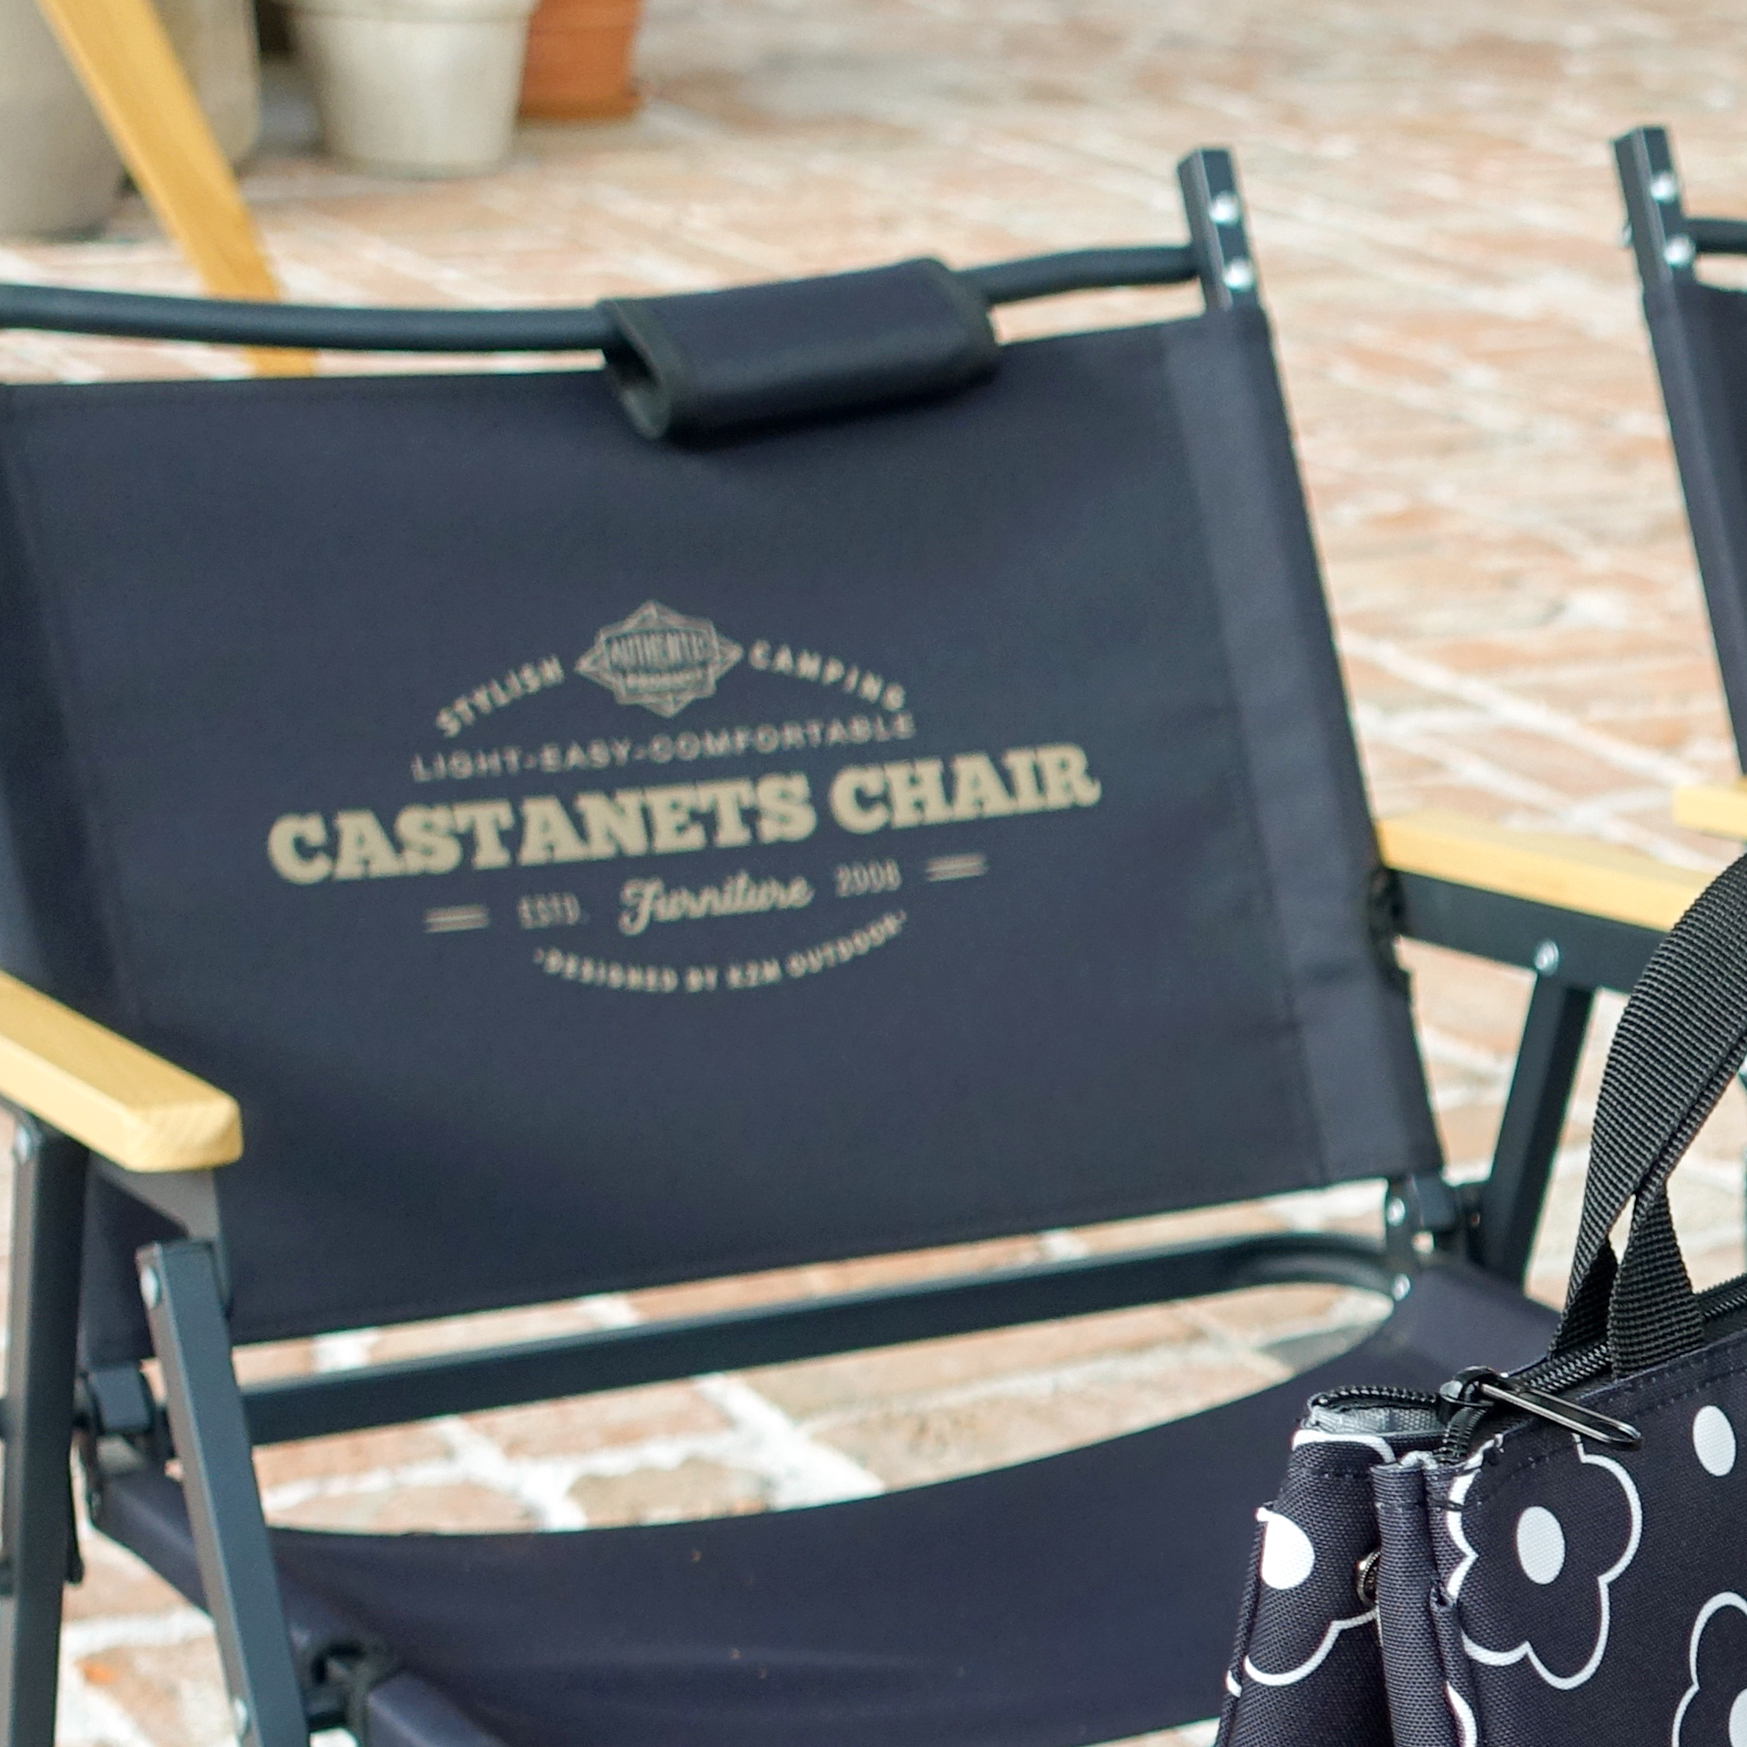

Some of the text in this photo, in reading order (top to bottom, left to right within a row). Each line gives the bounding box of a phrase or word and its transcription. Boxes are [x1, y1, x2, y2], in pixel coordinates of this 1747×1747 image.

[435, 639, 906, 738] STYLISH CAMPING
[266, 742, 1103, 885] CASTANETS CHAIR
[617, 869, 815, 937] Furniture
